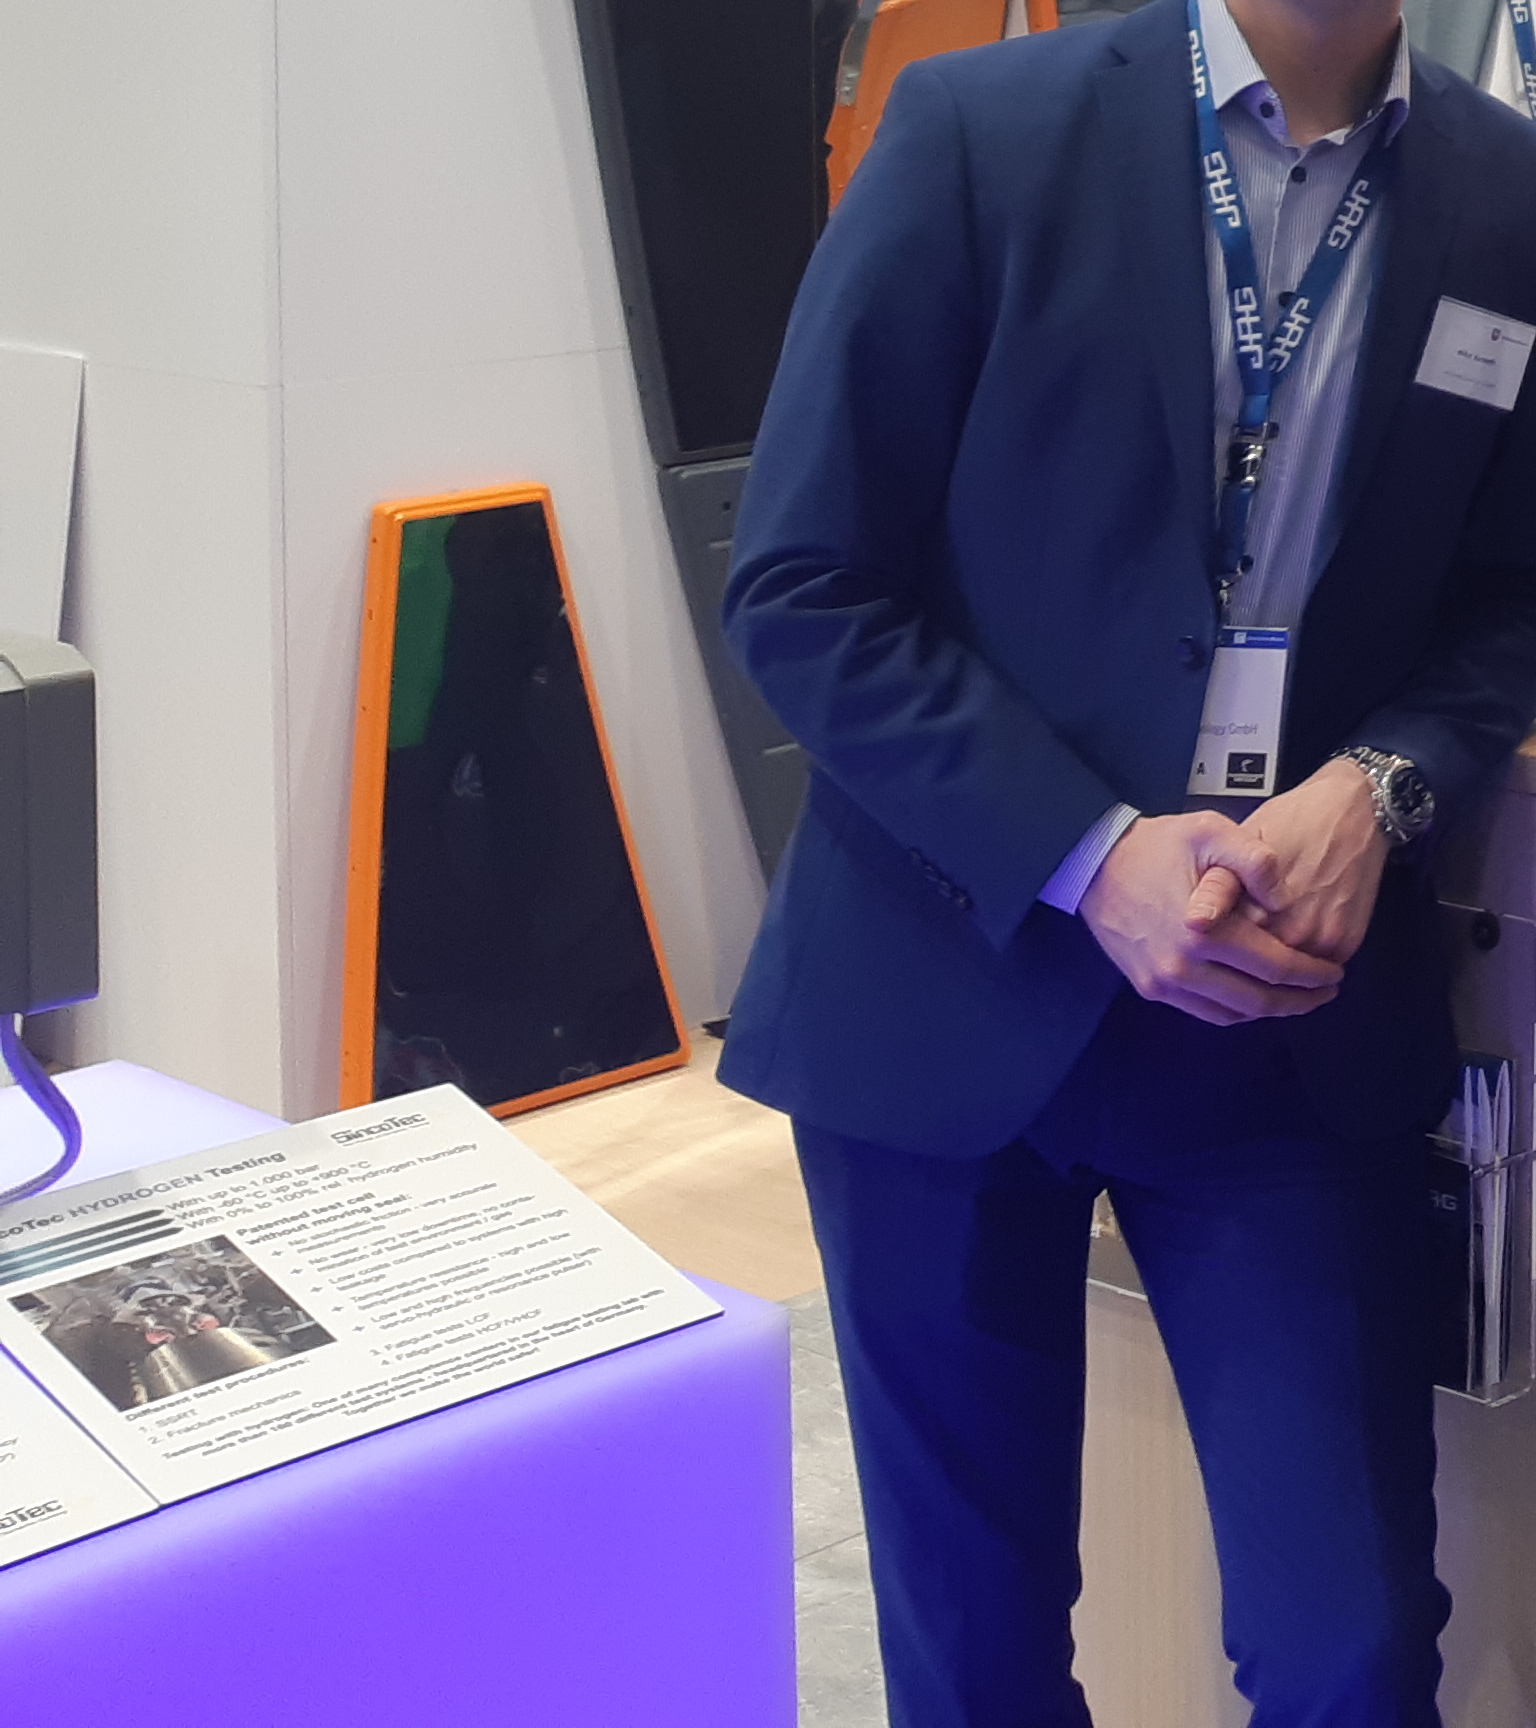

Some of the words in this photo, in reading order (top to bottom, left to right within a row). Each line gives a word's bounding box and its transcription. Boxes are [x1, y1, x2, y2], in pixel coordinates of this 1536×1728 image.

[1204, 148, 1242, 229] JAG
[1327, 178, 1371, 251] JAG
[1232, 285, 1266, 371] JAG
[331, 1113, 427, 1144] SincoTec
[67, 1173, 205, 1218] HYDROGEN
[203, 1152, 287, 1178] Testing
